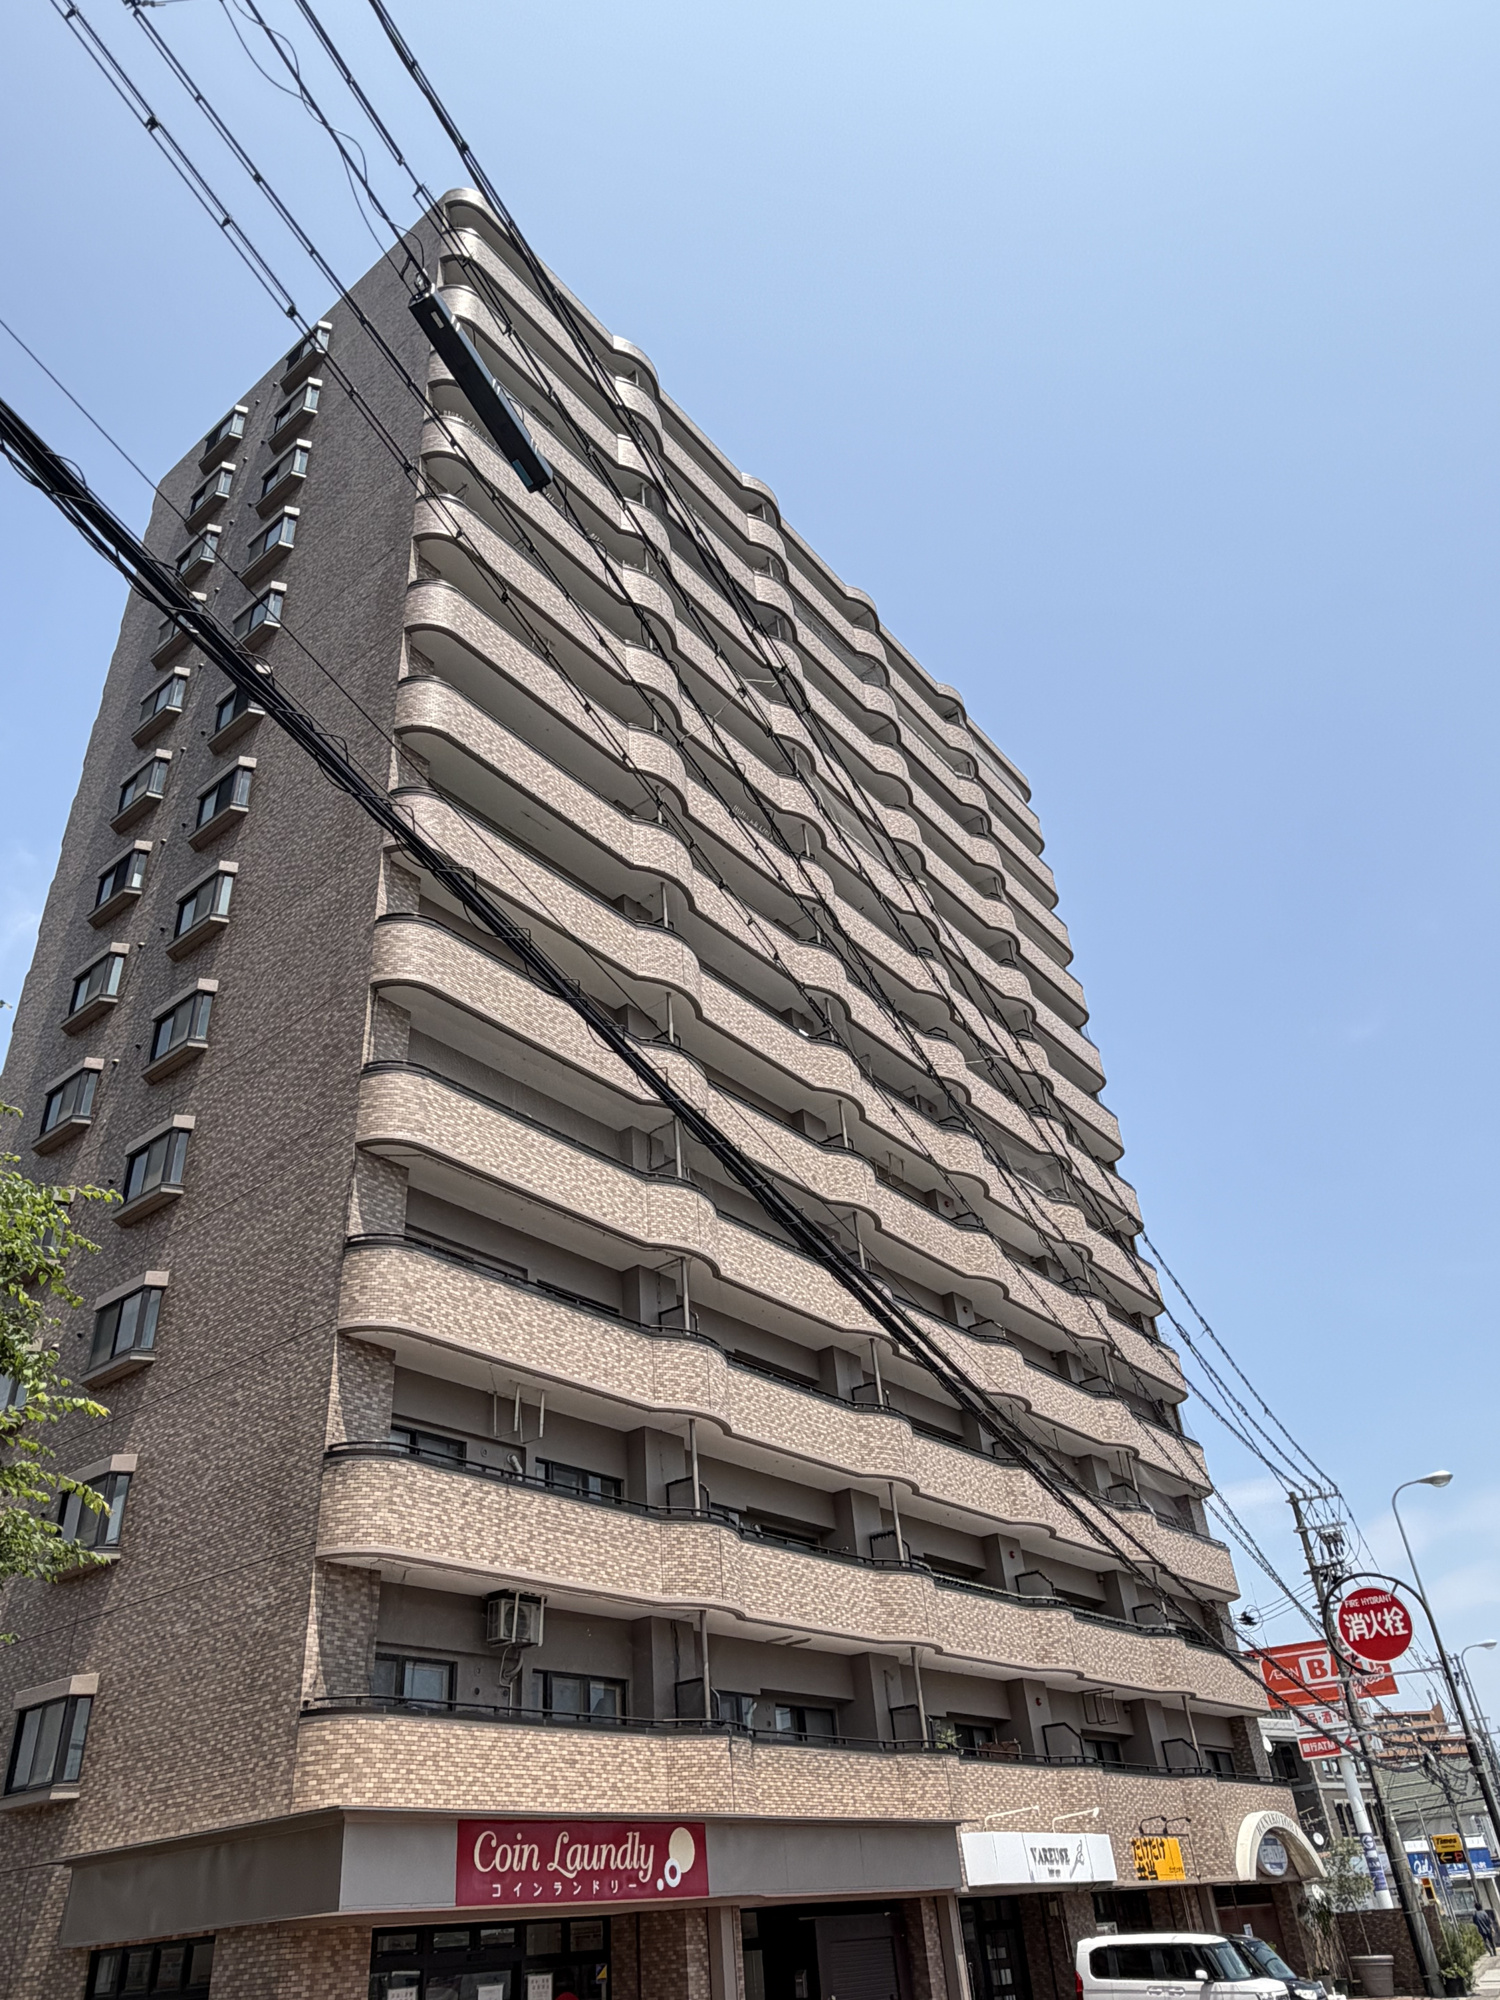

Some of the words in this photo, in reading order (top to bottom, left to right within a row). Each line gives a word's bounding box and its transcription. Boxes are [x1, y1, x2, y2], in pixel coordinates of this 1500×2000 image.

[1344, 1599, 1360, 1609] FIRE
[1360, 1594, 1392, 1606] HYDRANT
[1343, 1606, 1409, 1642] 消火栓
[1436, 1837, 1457, 1845] Times
[473, 1830, 540, 1873] Coin
[546, 1831, 655, 1883] Laundly
[1454, 1851, 1464, 1863] P
[492, 1879, 638, 1897] コインランドリー
